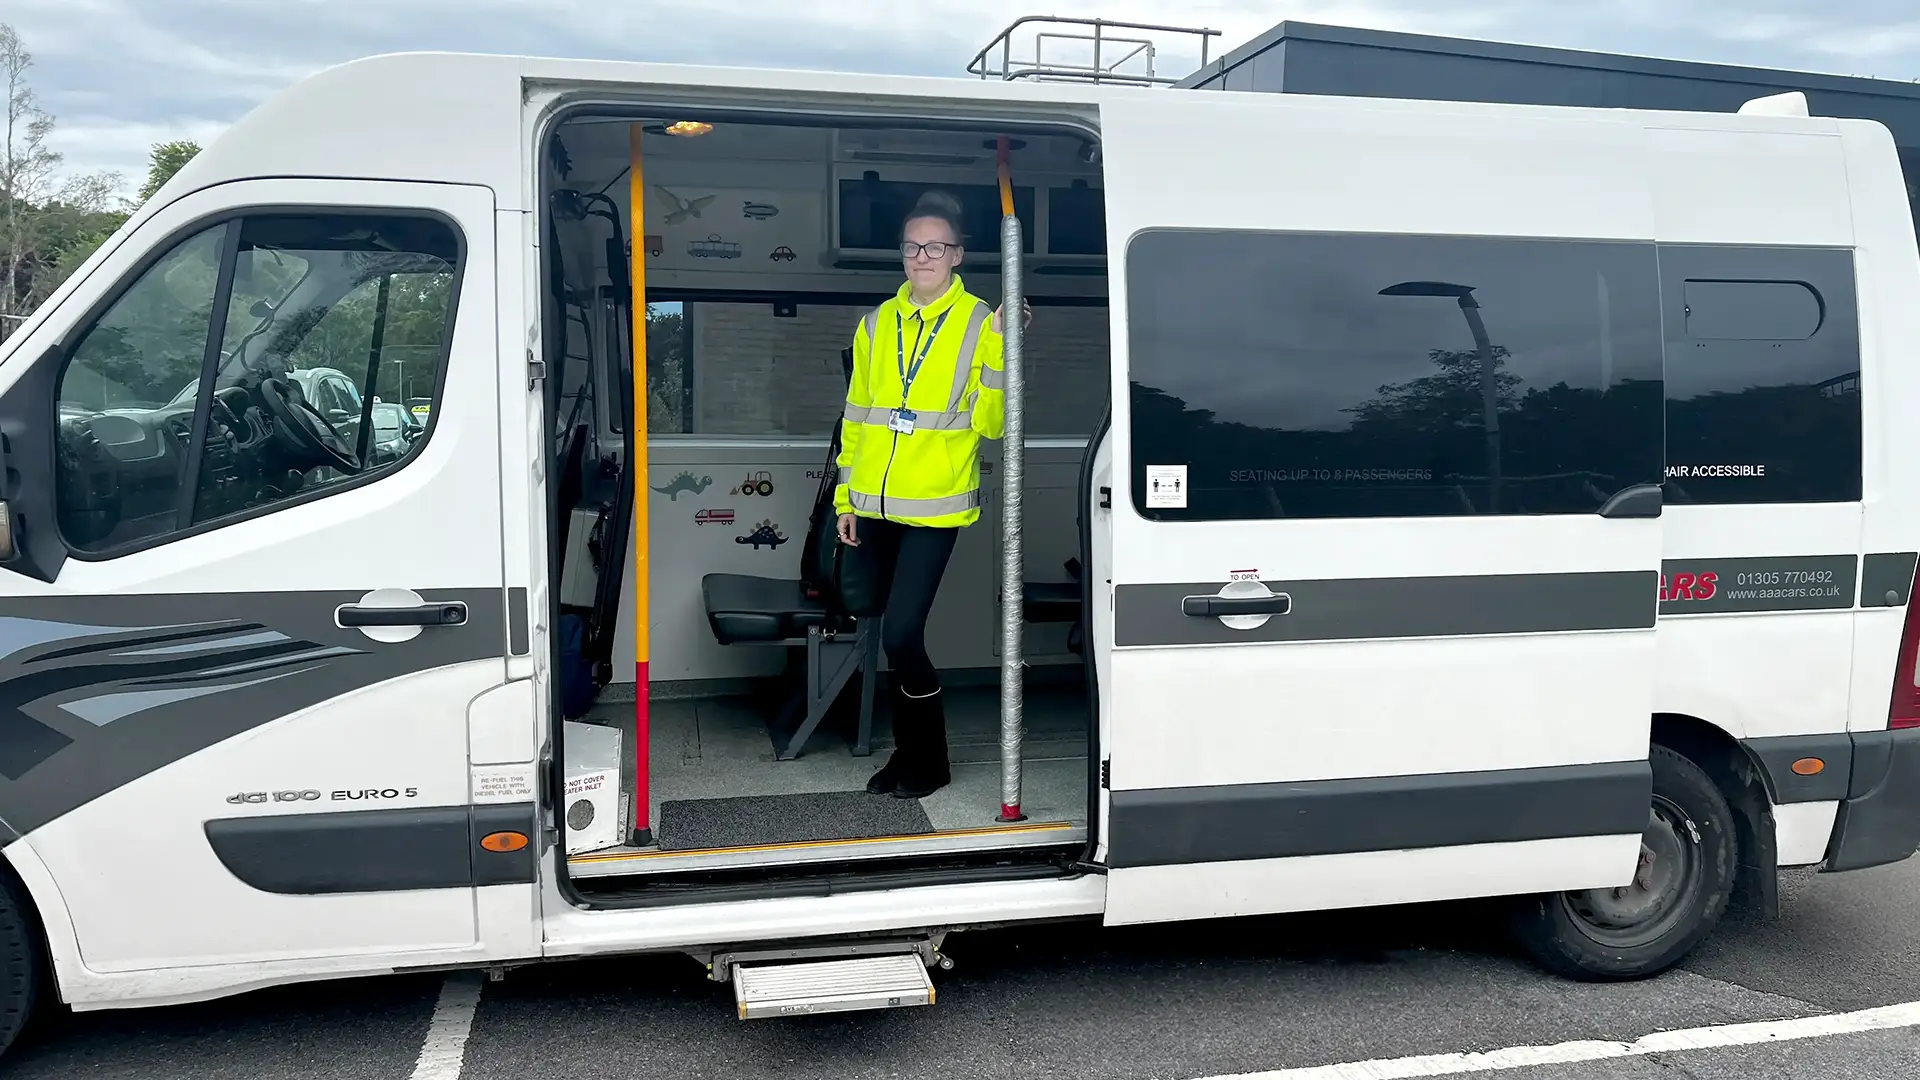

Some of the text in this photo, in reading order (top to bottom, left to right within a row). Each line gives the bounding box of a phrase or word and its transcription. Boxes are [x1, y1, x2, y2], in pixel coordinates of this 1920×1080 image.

[1230, 469, 1432, 481] SEATING UP TO 8 PASSENGERS
[1691, 465, 1765, 477] ACCESSIBLE
[1737, 571, 1833, 585] 01305 770492
[1727, 585, 1840, 600] www.aaacars.co.uk
[583, 775, 605, 784] COVER
[585, 782, 602, 791] INLET
[272, 789, 321, 802] 100
[331, 789, 399, 801] EURO
[405, 787, 418, 798] 5
